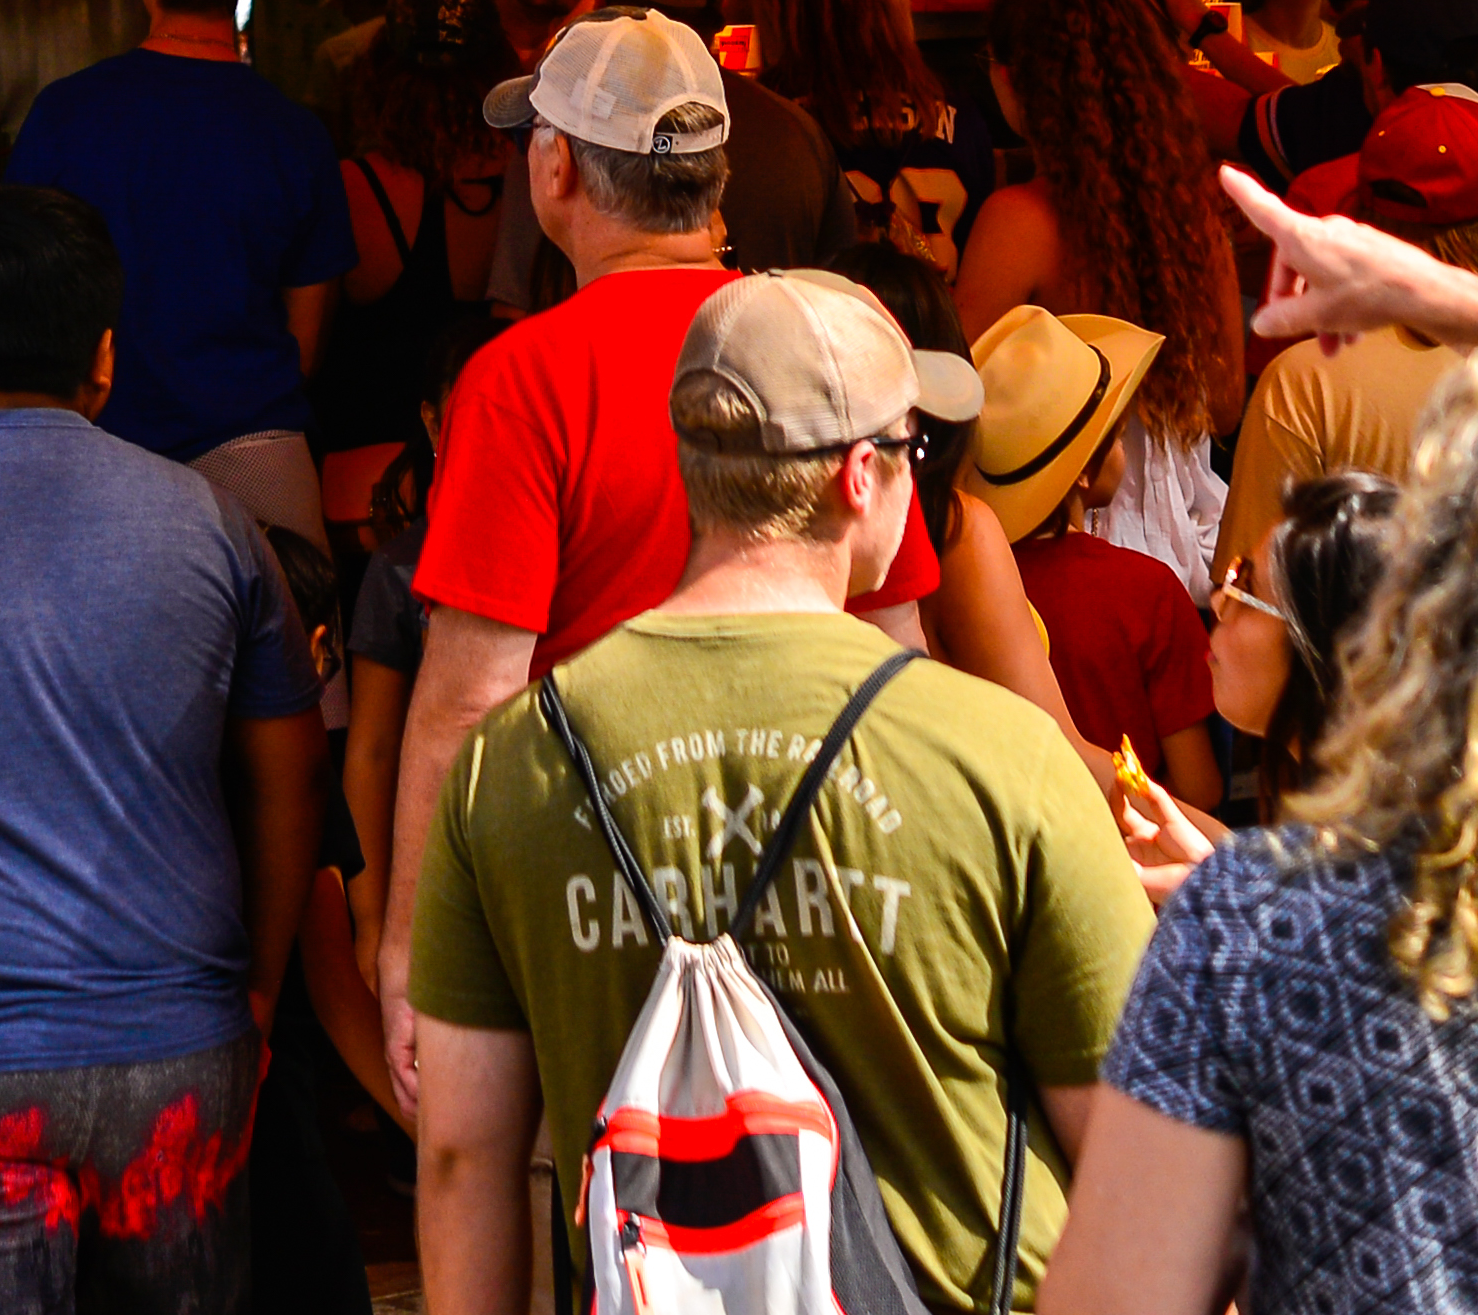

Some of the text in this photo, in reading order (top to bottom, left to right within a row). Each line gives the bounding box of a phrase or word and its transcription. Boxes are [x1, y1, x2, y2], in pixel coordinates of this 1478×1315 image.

[573, 728, 903, 835] FGED FROM THE RAROAD
[565, 857, 912, 957] CARHARTT
[813, 967, 850, 993] ALL
